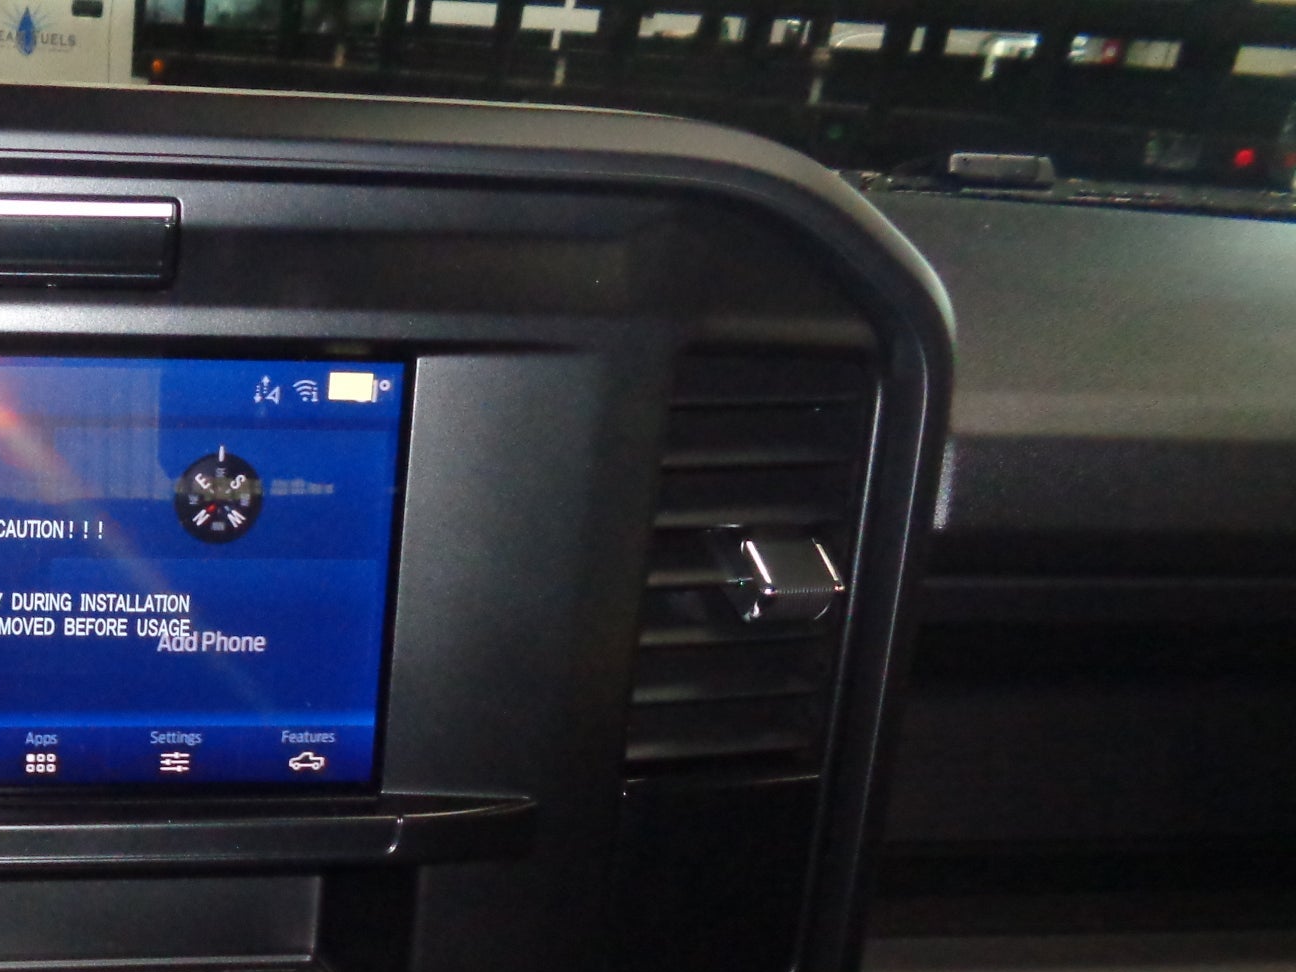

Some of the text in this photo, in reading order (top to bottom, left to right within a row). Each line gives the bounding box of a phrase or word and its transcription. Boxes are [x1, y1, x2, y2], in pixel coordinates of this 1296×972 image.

[194, 473, 211, 489] E
[230, 474, 246, 489] S
[192, 509, 210, 526] N
[12, 593, 71, 611] DURING
[81, 594, 190, 612] INSTALLATION
[64, 618, 128, 636] BEFORE
[137, 618, 191, 637] USAGE
[157, 631, 266, 652] Add Phone
[25, 732, 58, 749] Apps
[150, 730, 202, 748] Settings
[281, 729, 336, 744] Features
